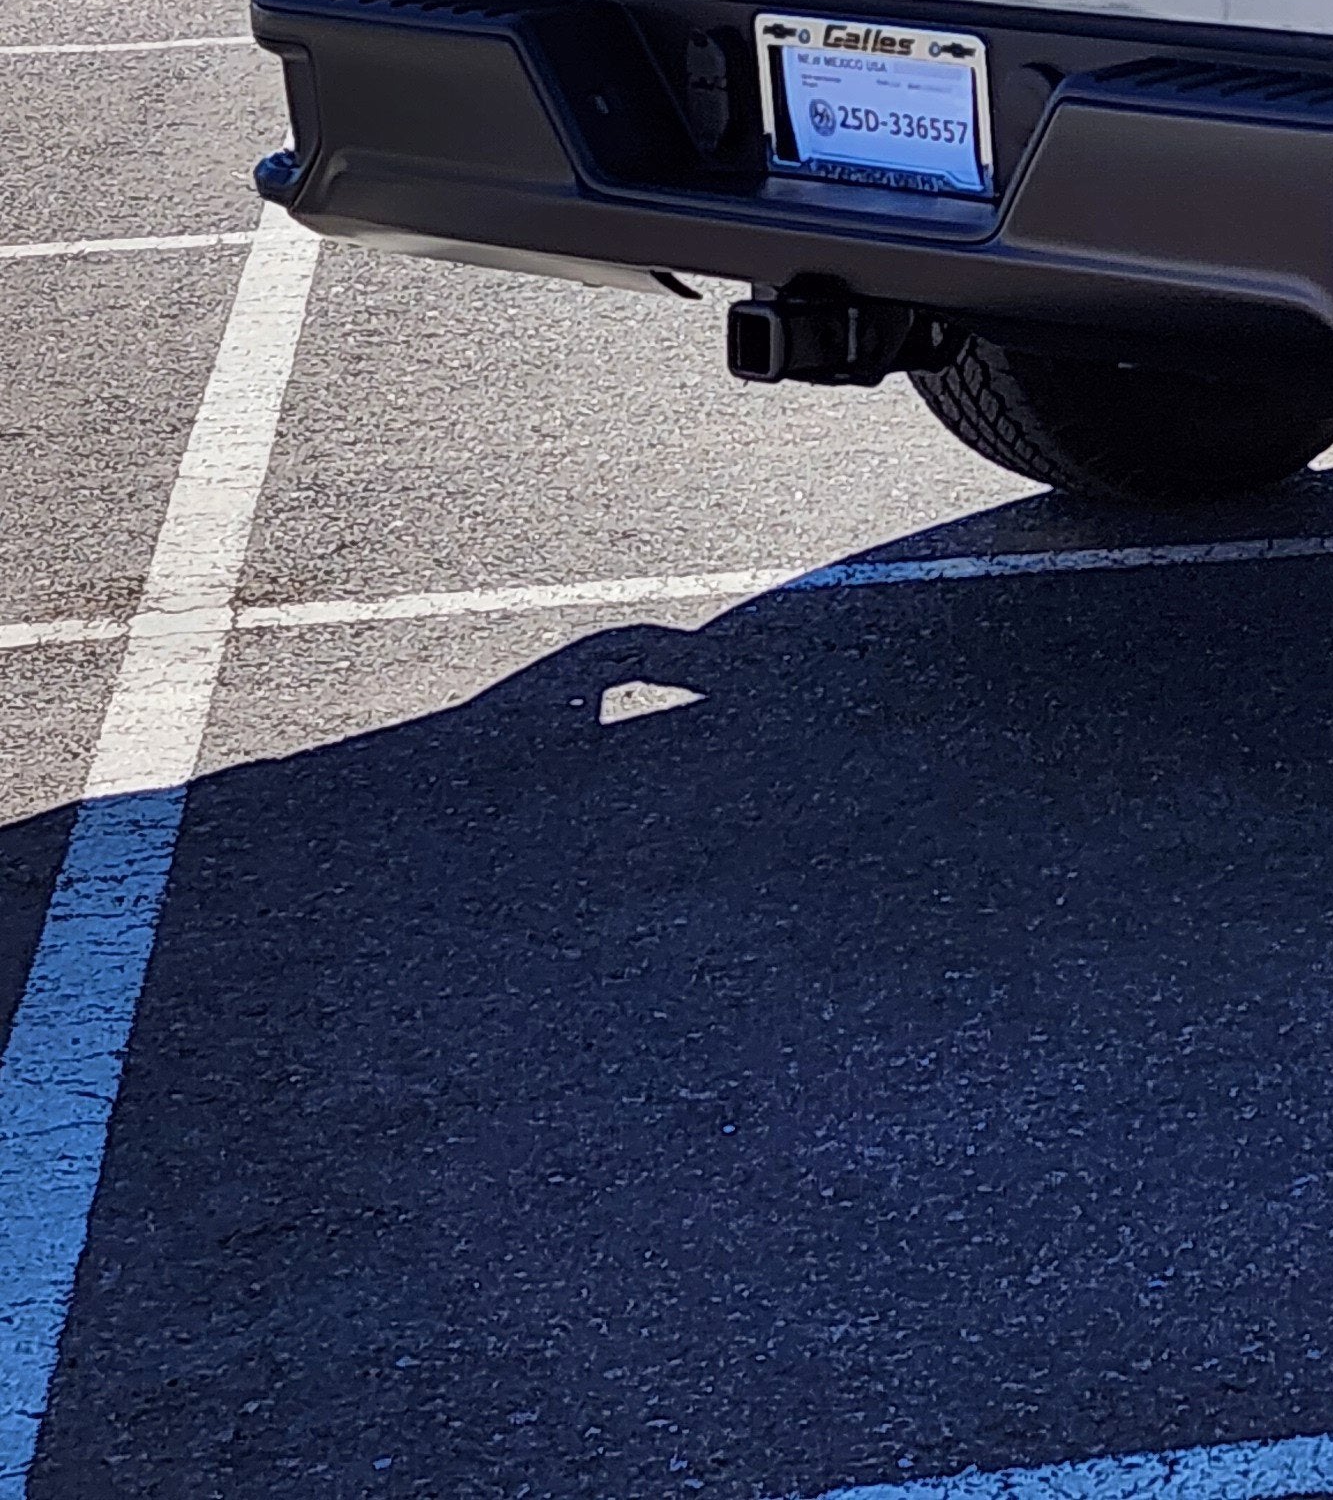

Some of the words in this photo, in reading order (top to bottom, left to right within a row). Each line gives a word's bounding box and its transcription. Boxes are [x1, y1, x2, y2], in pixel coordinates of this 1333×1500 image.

[822, 24, 916, 56] Galles
[824, 56, 863, 71] MEXICO
[866, 61, 888, 73] USA
[838, 105, 968, 145] 25D-336557
